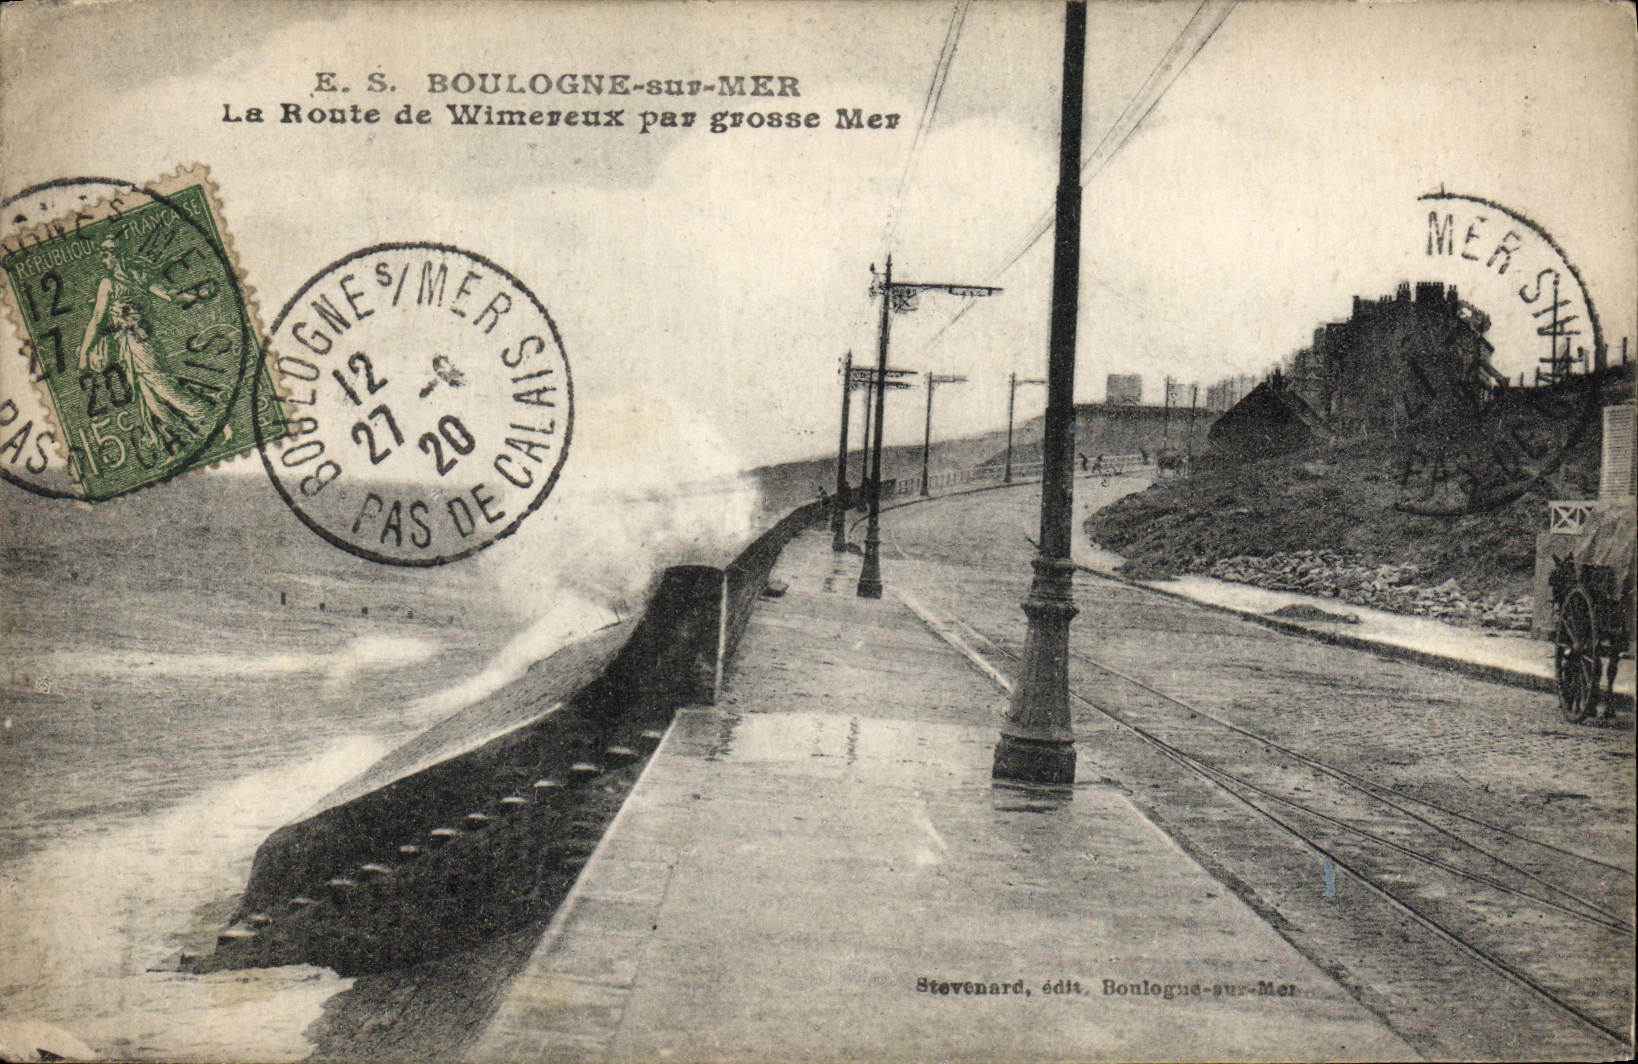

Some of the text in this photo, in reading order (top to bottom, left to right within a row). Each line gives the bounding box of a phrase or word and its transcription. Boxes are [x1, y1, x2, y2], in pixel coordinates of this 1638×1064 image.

[1425, 210, 1521, 275] MER
[332, 351, 389, 405] 12
[350, 403, 476, 477] 27 20
[352, 335, 557, 549] PAS DE CALAIS
